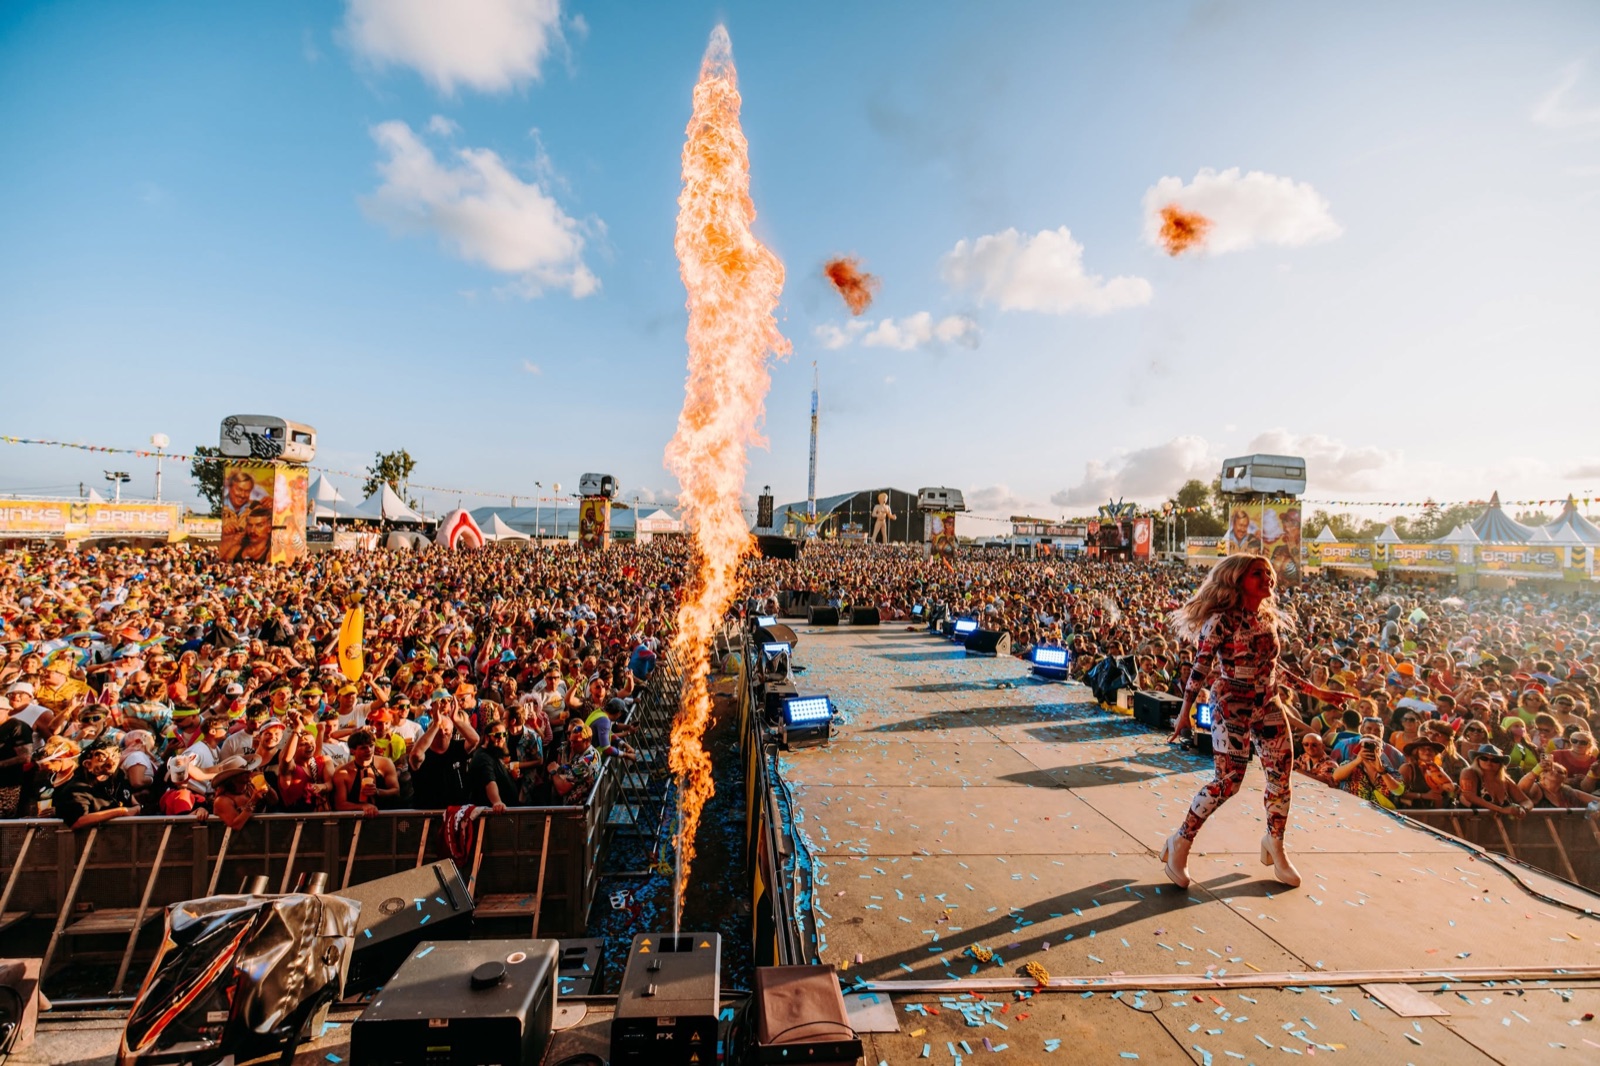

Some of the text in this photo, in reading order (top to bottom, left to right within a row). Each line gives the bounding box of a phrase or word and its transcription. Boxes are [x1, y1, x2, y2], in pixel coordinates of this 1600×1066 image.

[0, 508, 61, 521] INKS
[96, 510, 168, 523] DRINKS
[1324, 547, 1370, 557] DRINKS
[1394, 549, 1452, 560] DRINKS
[1481, 551, 1555, 564] DRINKS
